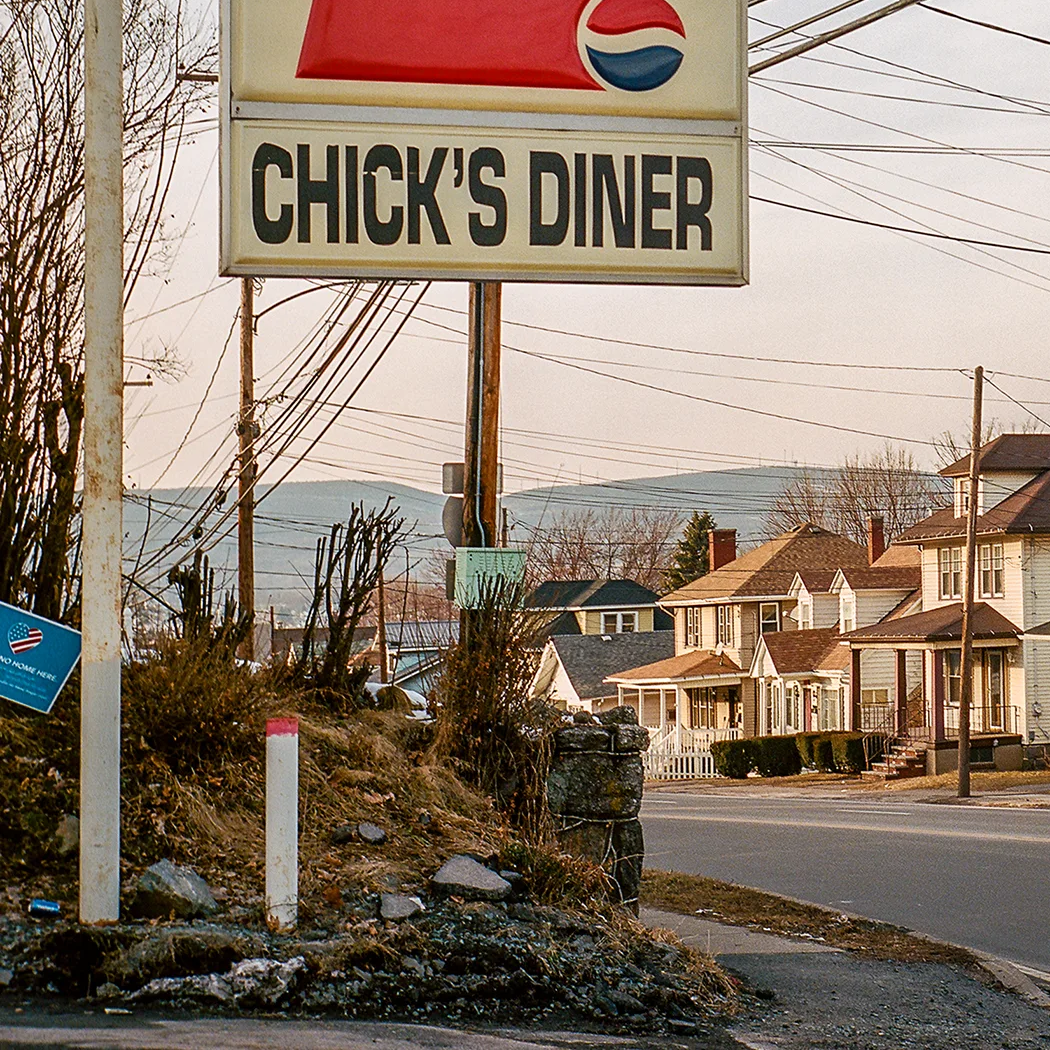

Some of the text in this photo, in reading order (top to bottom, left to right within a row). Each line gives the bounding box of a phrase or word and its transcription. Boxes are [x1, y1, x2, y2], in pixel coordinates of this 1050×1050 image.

[252, 142, 713, 251] CHICK'S DINER
[12, 661, 36, 674] HOME
